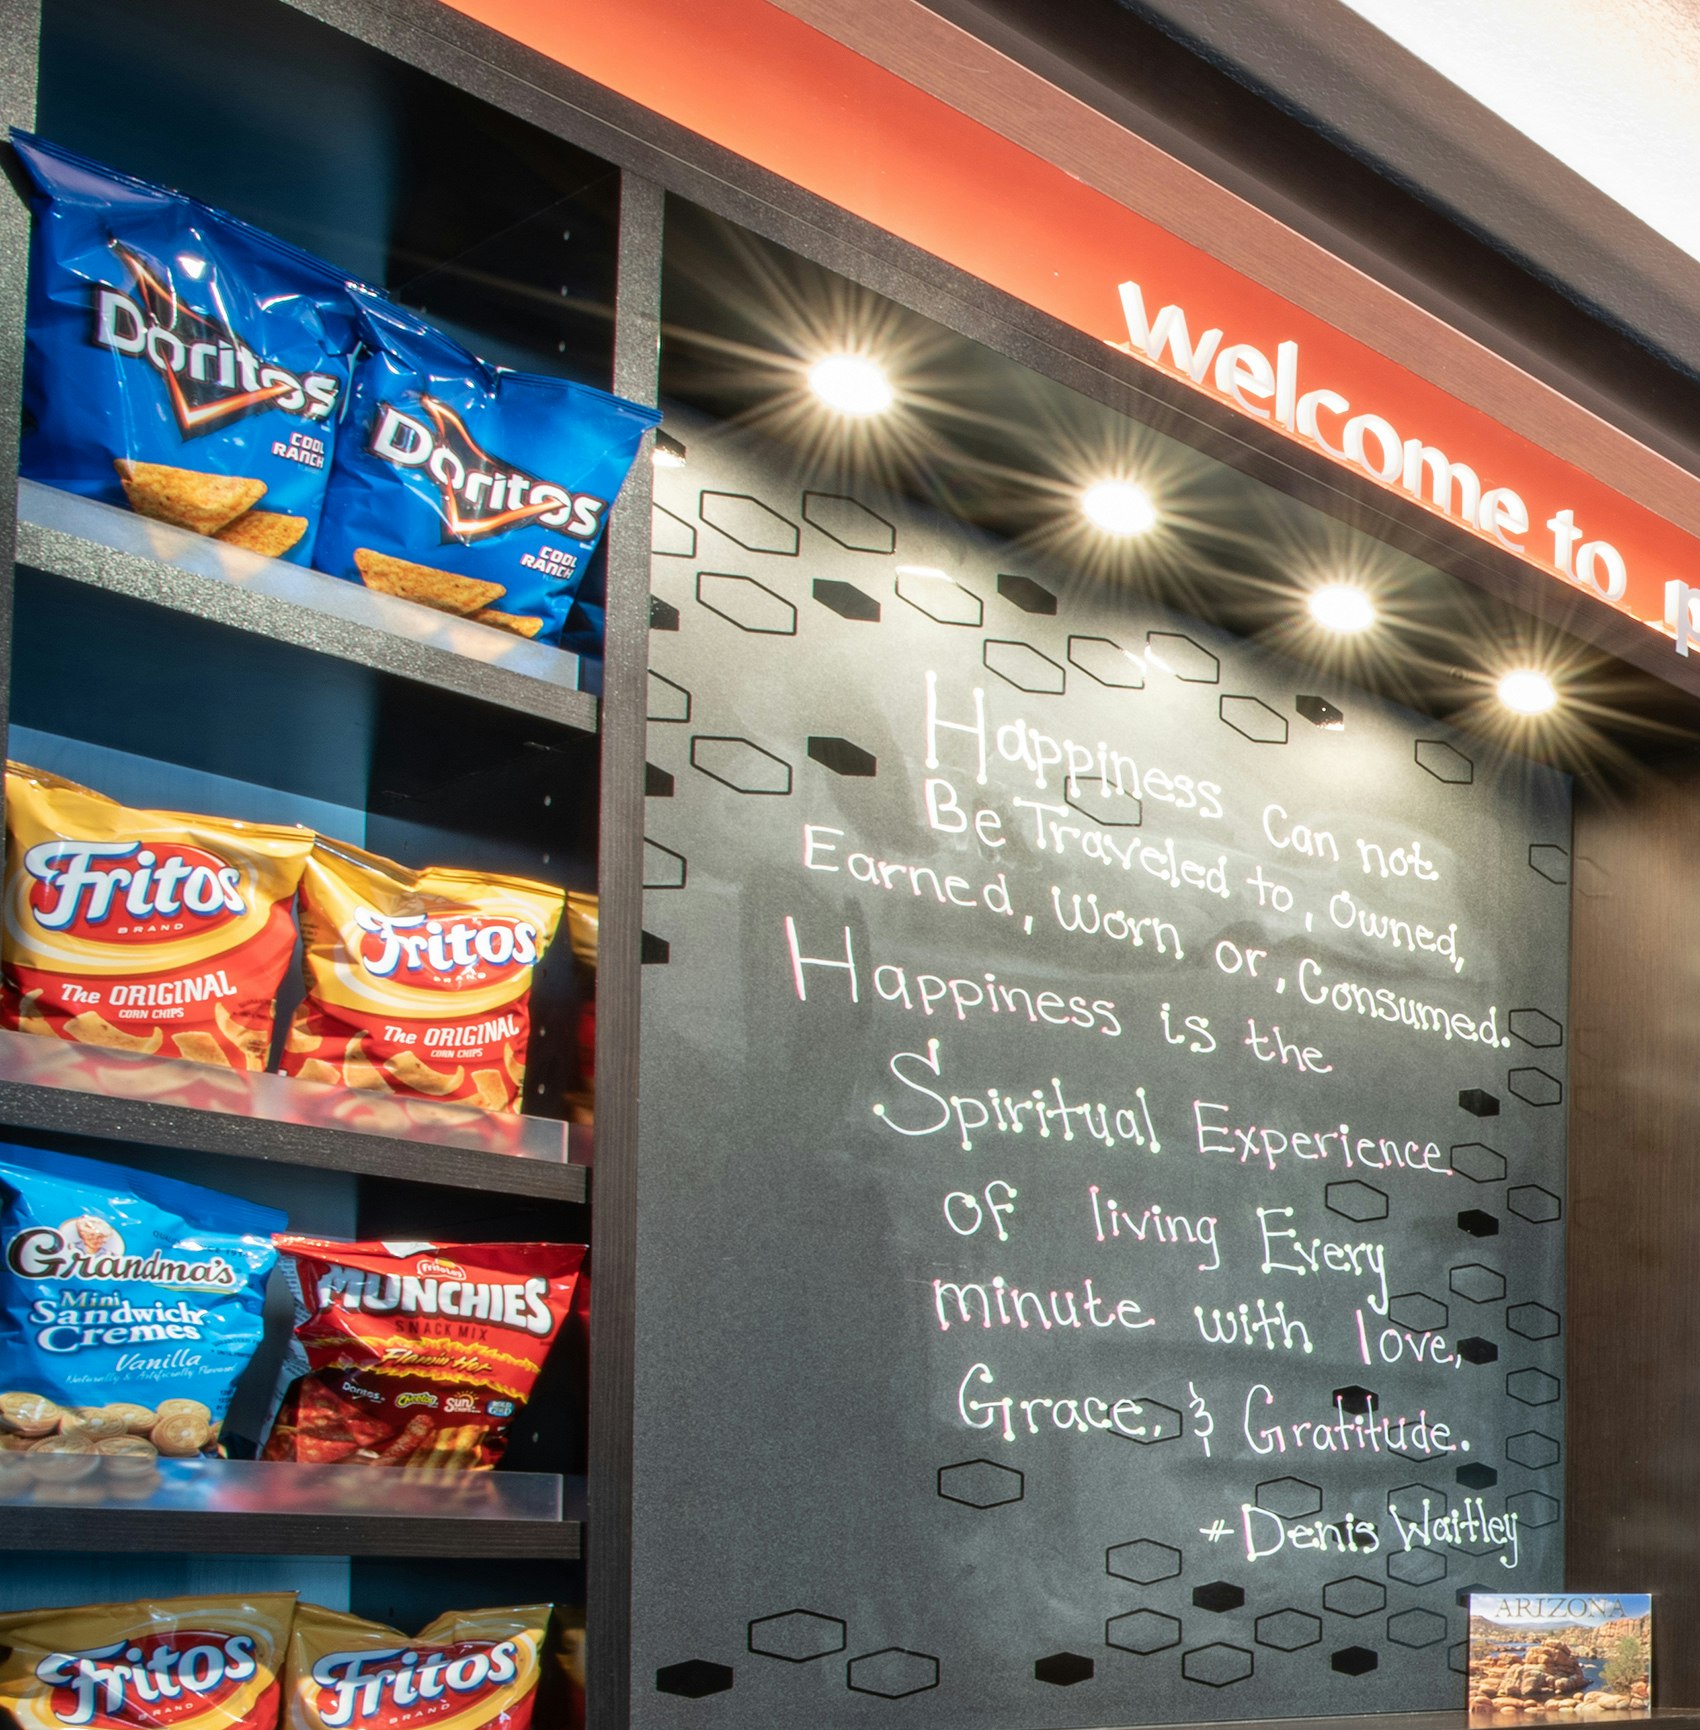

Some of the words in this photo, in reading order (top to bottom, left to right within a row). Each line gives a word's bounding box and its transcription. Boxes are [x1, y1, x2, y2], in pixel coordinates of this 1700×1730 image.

[93, 285, 340, 423] Doritos
[272, 441, 326, 470] RANCH
[289, 431, 326, 455] COOL
[371, 401, 605, 539] Doritos
[520, 553, 575, 580] RANCH
[539, 545, 579, 570] COOL
[1547, 509, 1628, 603] to
[924, 670, 1224, 820] Happiness
[1262, 804, 1340, 862] Can
[924, 778, 1006, 849] Be
[1014, 795, 1230, 898] Traveled
[23, 839, 248, 930] Fritos
[118, 922, 185, 934] BRAND
[354, 905, 542, 977] Fritos
[802, 824, 1033, 935] Earned,
[1299, 959, 1511, 1049] Consumed.
[61, 982, 101, 1004] The
[109, 970, 238, 1006] ORIGINAL
[118, 1008, 149, 1020] CORN
[151, 1006, 185, 1019] CHIPS
[785, 915, 1122, 1038] Happiness
[1161, 1004, 1218, 1052] is
[1245, 1018, 1332, 1072] the
[384, 1025, 418, 1046] The
[422, 1014, 521, 1047] ORIGINAL
[430, 1048, 454, 1059] CORN
[457, 1047, 484, 1058] CHIPS
[874, 1039, 1160, 1151] Spiritual
[1193, 1099, 1454, 1175] Experience
[6, 1226, 237, 1287] Grandma's
[1089, 1185, 1220, 1270] living
[1255, 1207, 1390, 1314] Every
[29, 1297, 206, 1326] Sandwich
[60, 1290, 121, 1309] Mini
[317, 1266, 553, 1338] MUNCHIES
[395, 1318, 453, 1337] SNACK
[457, 1324, 488, 1341] MIX
[932, 1276, 1156, 1331] minute
[1194, 1299, 1314, 1352] with
[36, 1322, 201, 1353] Cremes
[115, 1350, 202, 1371] Vanilla
[958, 1362, 1162, 1440] Grace,
[1244, 1384, 1471, 1455] Gratitude.
[1241, 1502, 1380, 1562] Denis
[1389, 1498, 1520, 1568] Waitley
[1492, 1598, 1626, 1619] ARIZONA
[36, 1633, 257, 1726] Fritos
[311, 1639, 519, 1729] Fritos
